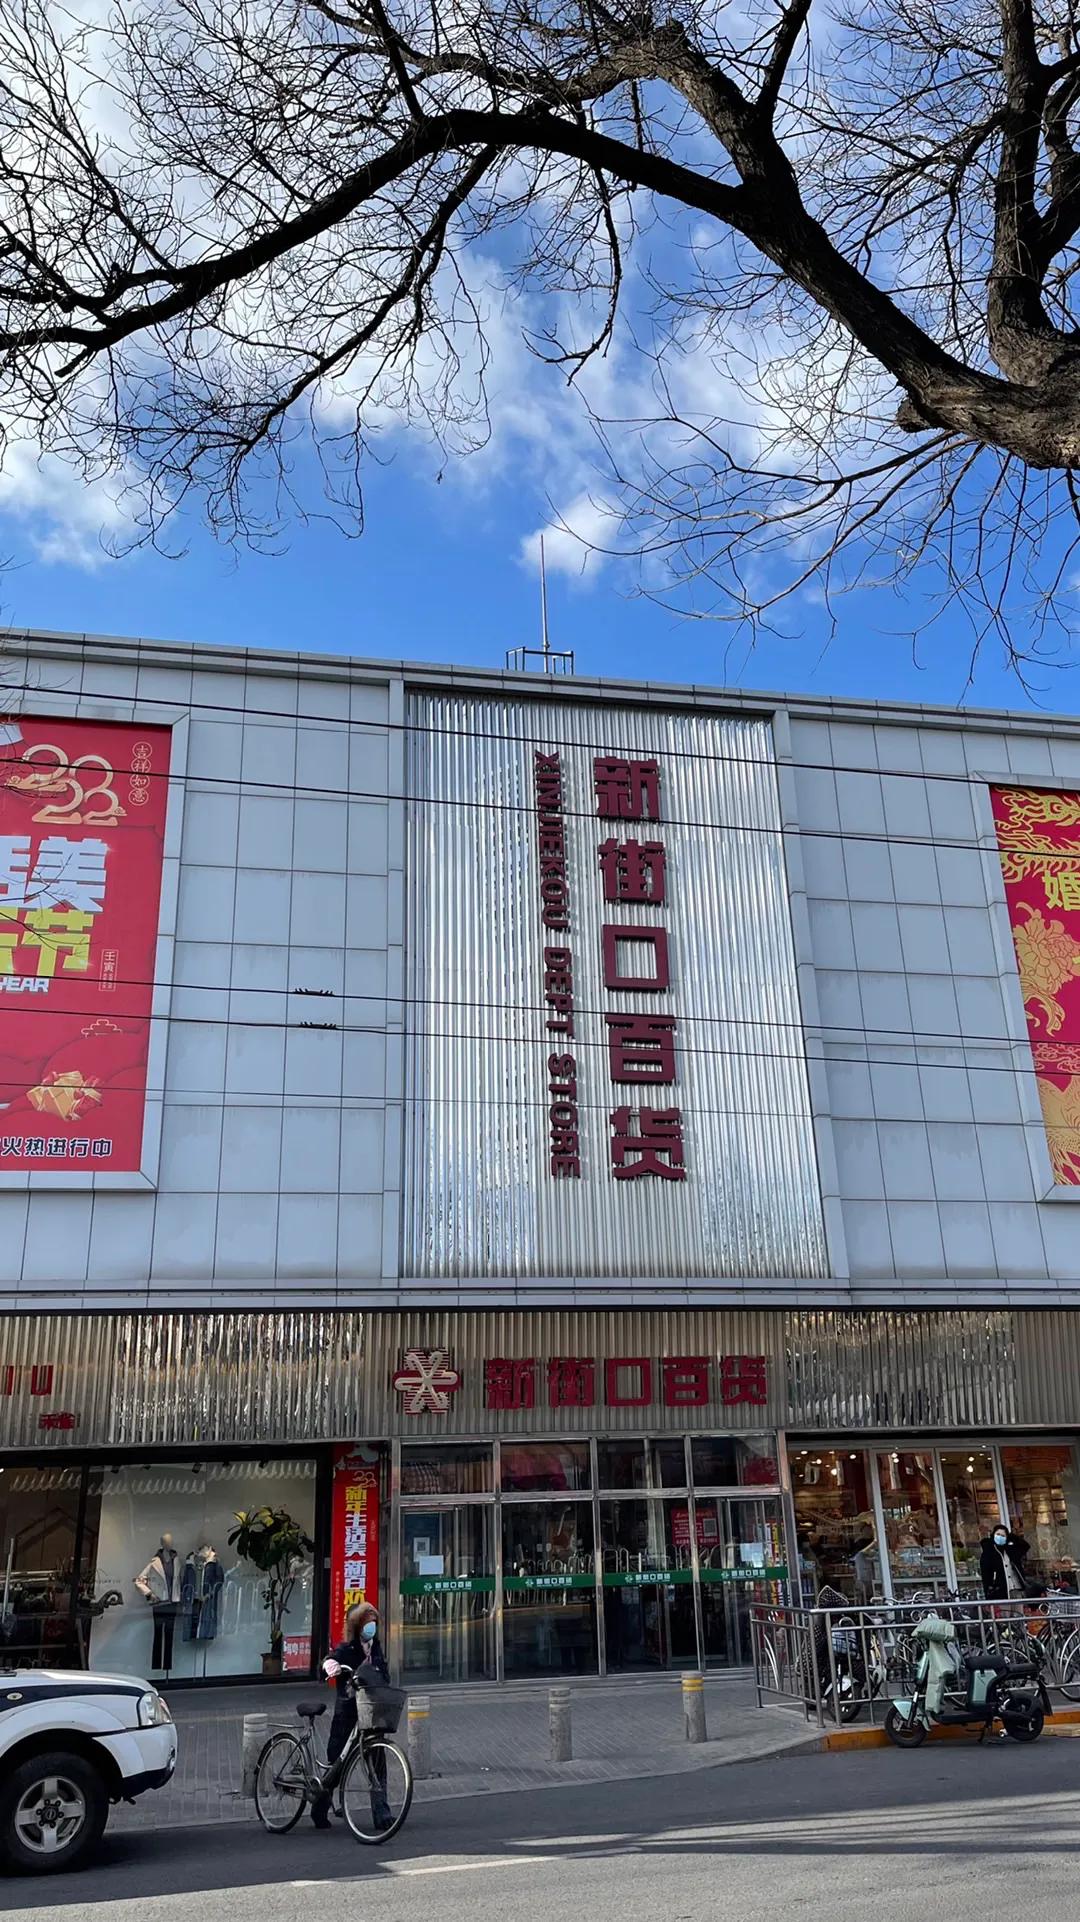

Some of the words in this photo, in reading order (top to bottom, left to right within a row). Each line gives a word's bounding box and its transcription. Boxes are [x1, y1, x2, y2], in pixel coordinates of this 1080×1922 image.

[535, 750, 570, 930] XINJIEKOU
[544, 946, 574, 1038] DEPT
[594, 755, 687, 1182] 新街口百货
[548, 1053, 580, 1178] STORE
[484, 1356, 767, 1410] 新街口百货
